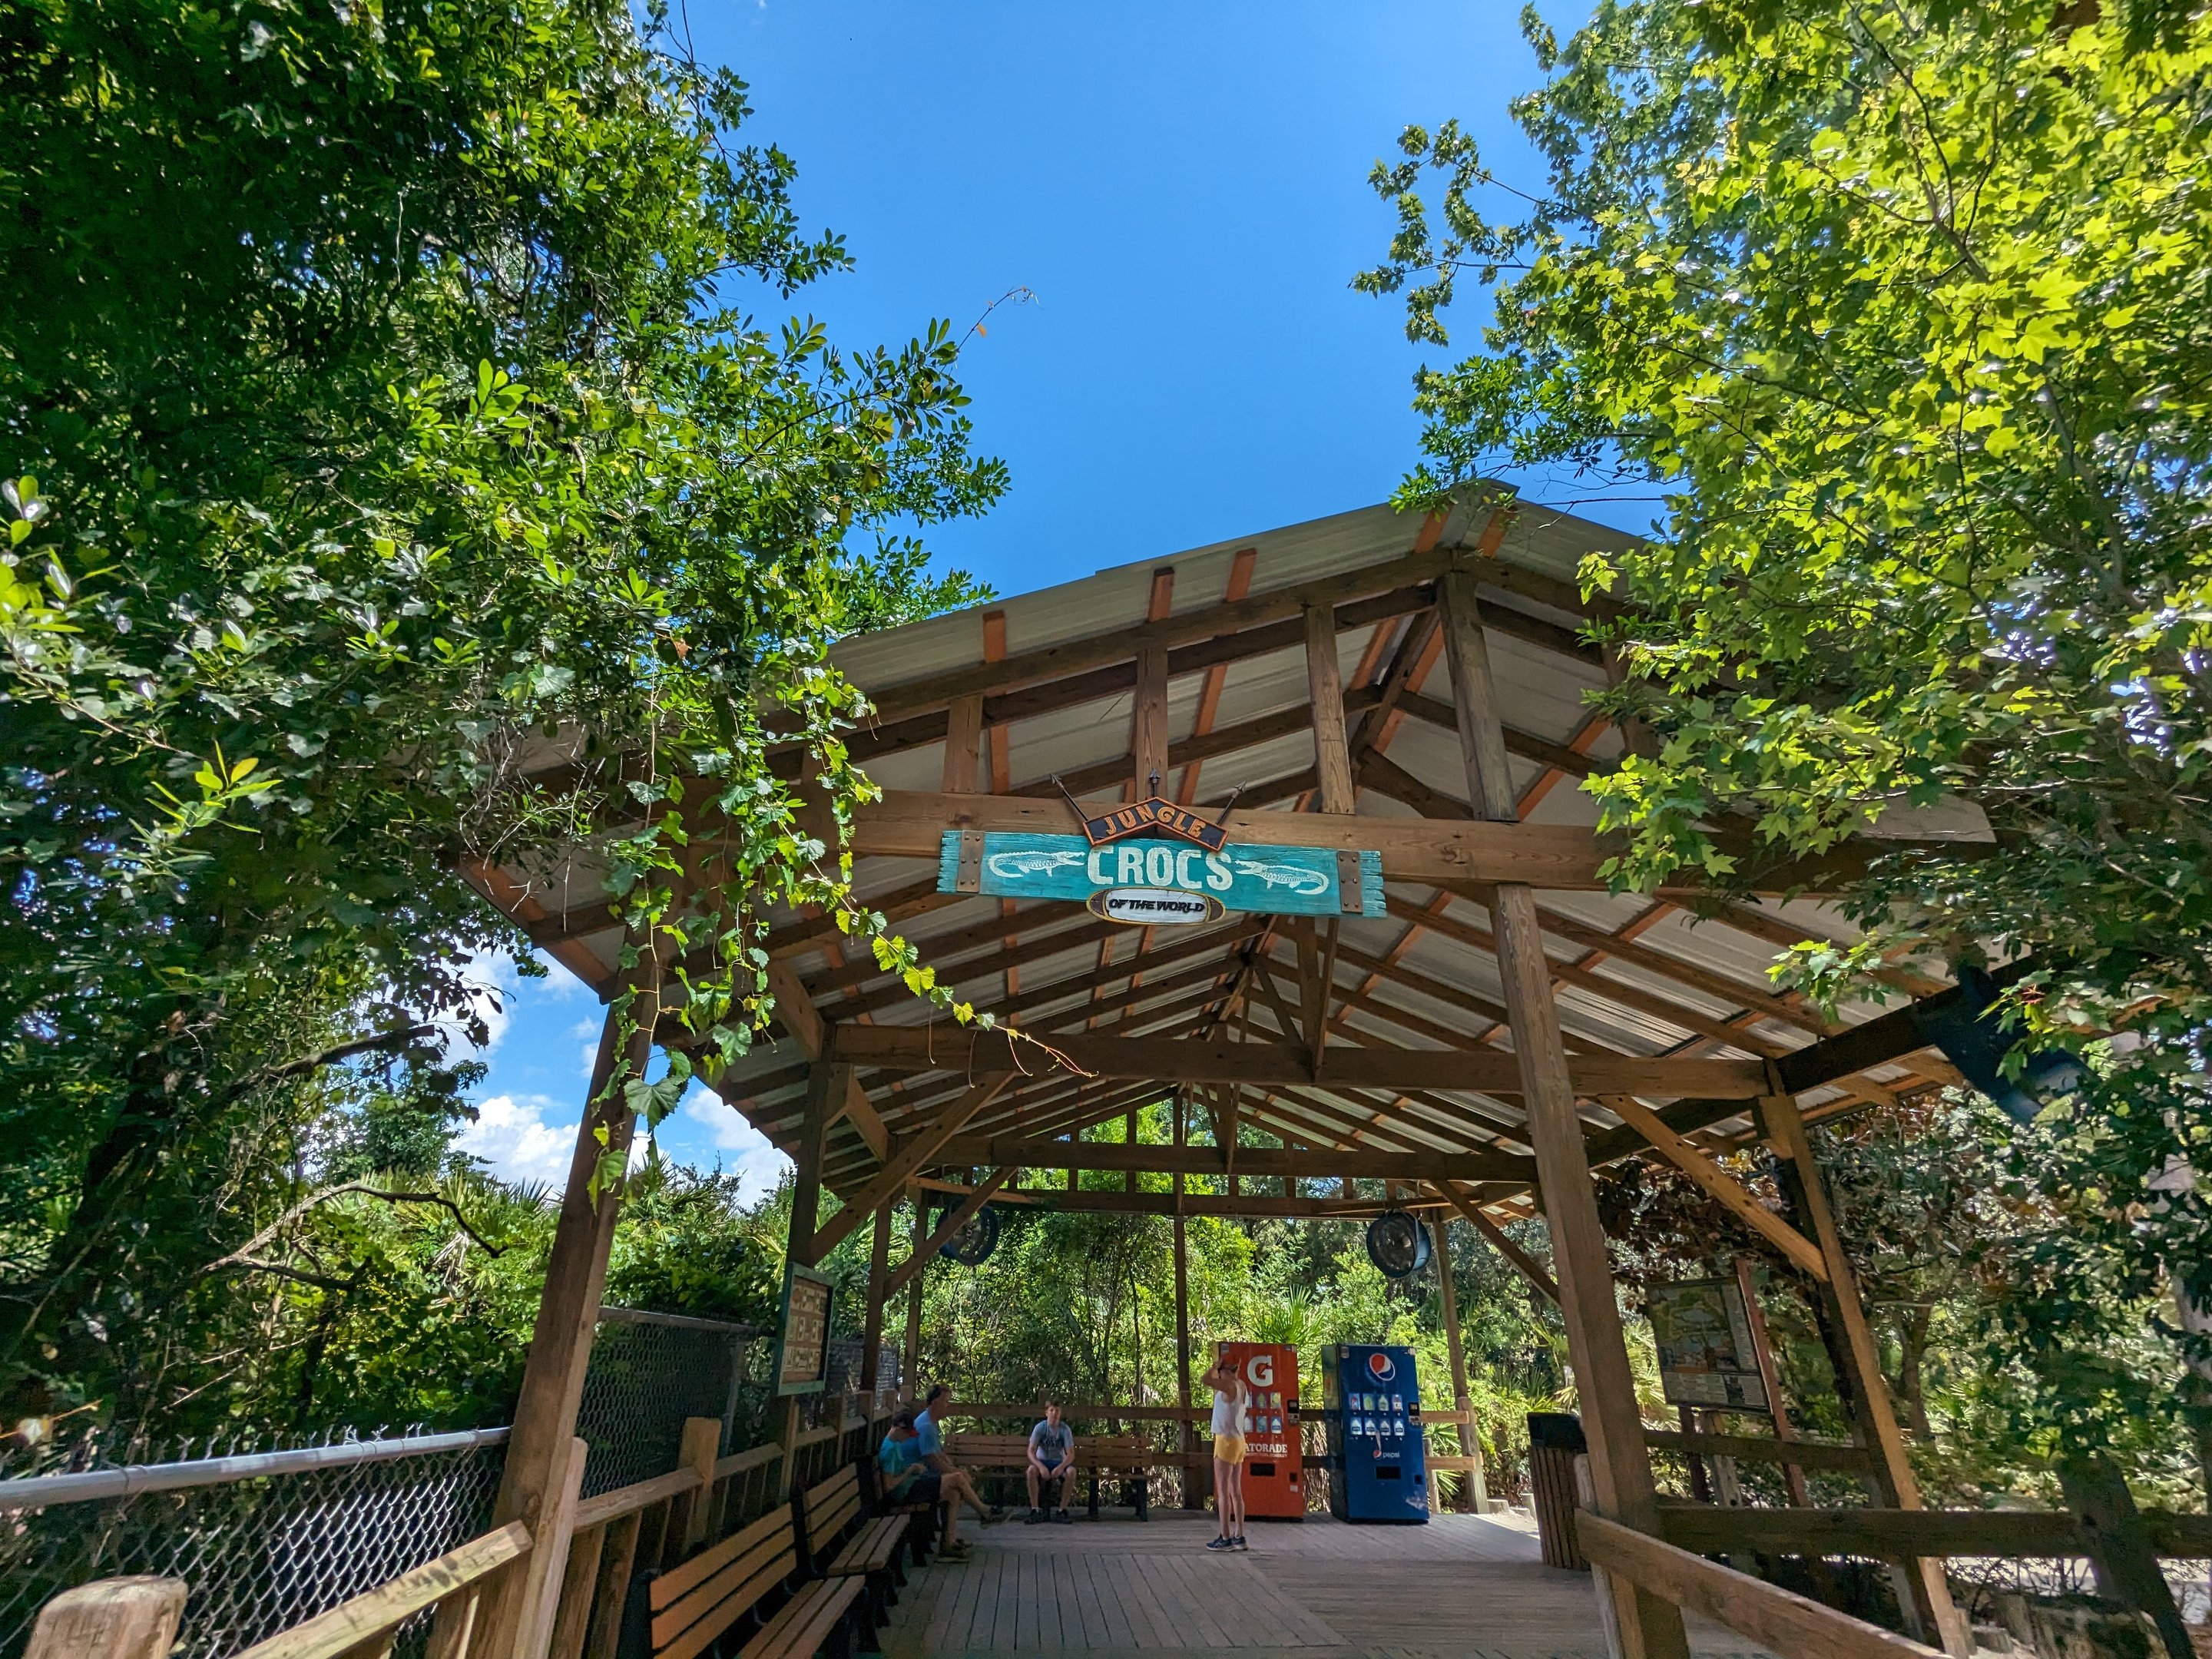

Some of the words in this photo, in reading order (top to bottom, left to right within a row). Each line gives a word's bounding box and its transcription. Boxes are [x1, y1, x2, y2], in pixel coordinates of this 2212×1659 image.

[1104, 804, 1207, 838] JUNGLE
[1088, 846, 1233, 891] CROCS
[1108, 899, 1128, 909] OF
[1128, 899, 1156, 910] THE
[1157, 901, 1205, 913] WORLD
[1247, 1355, 1273, 1387] G
[1245, 1444, 1287, 1453] ATORADE
